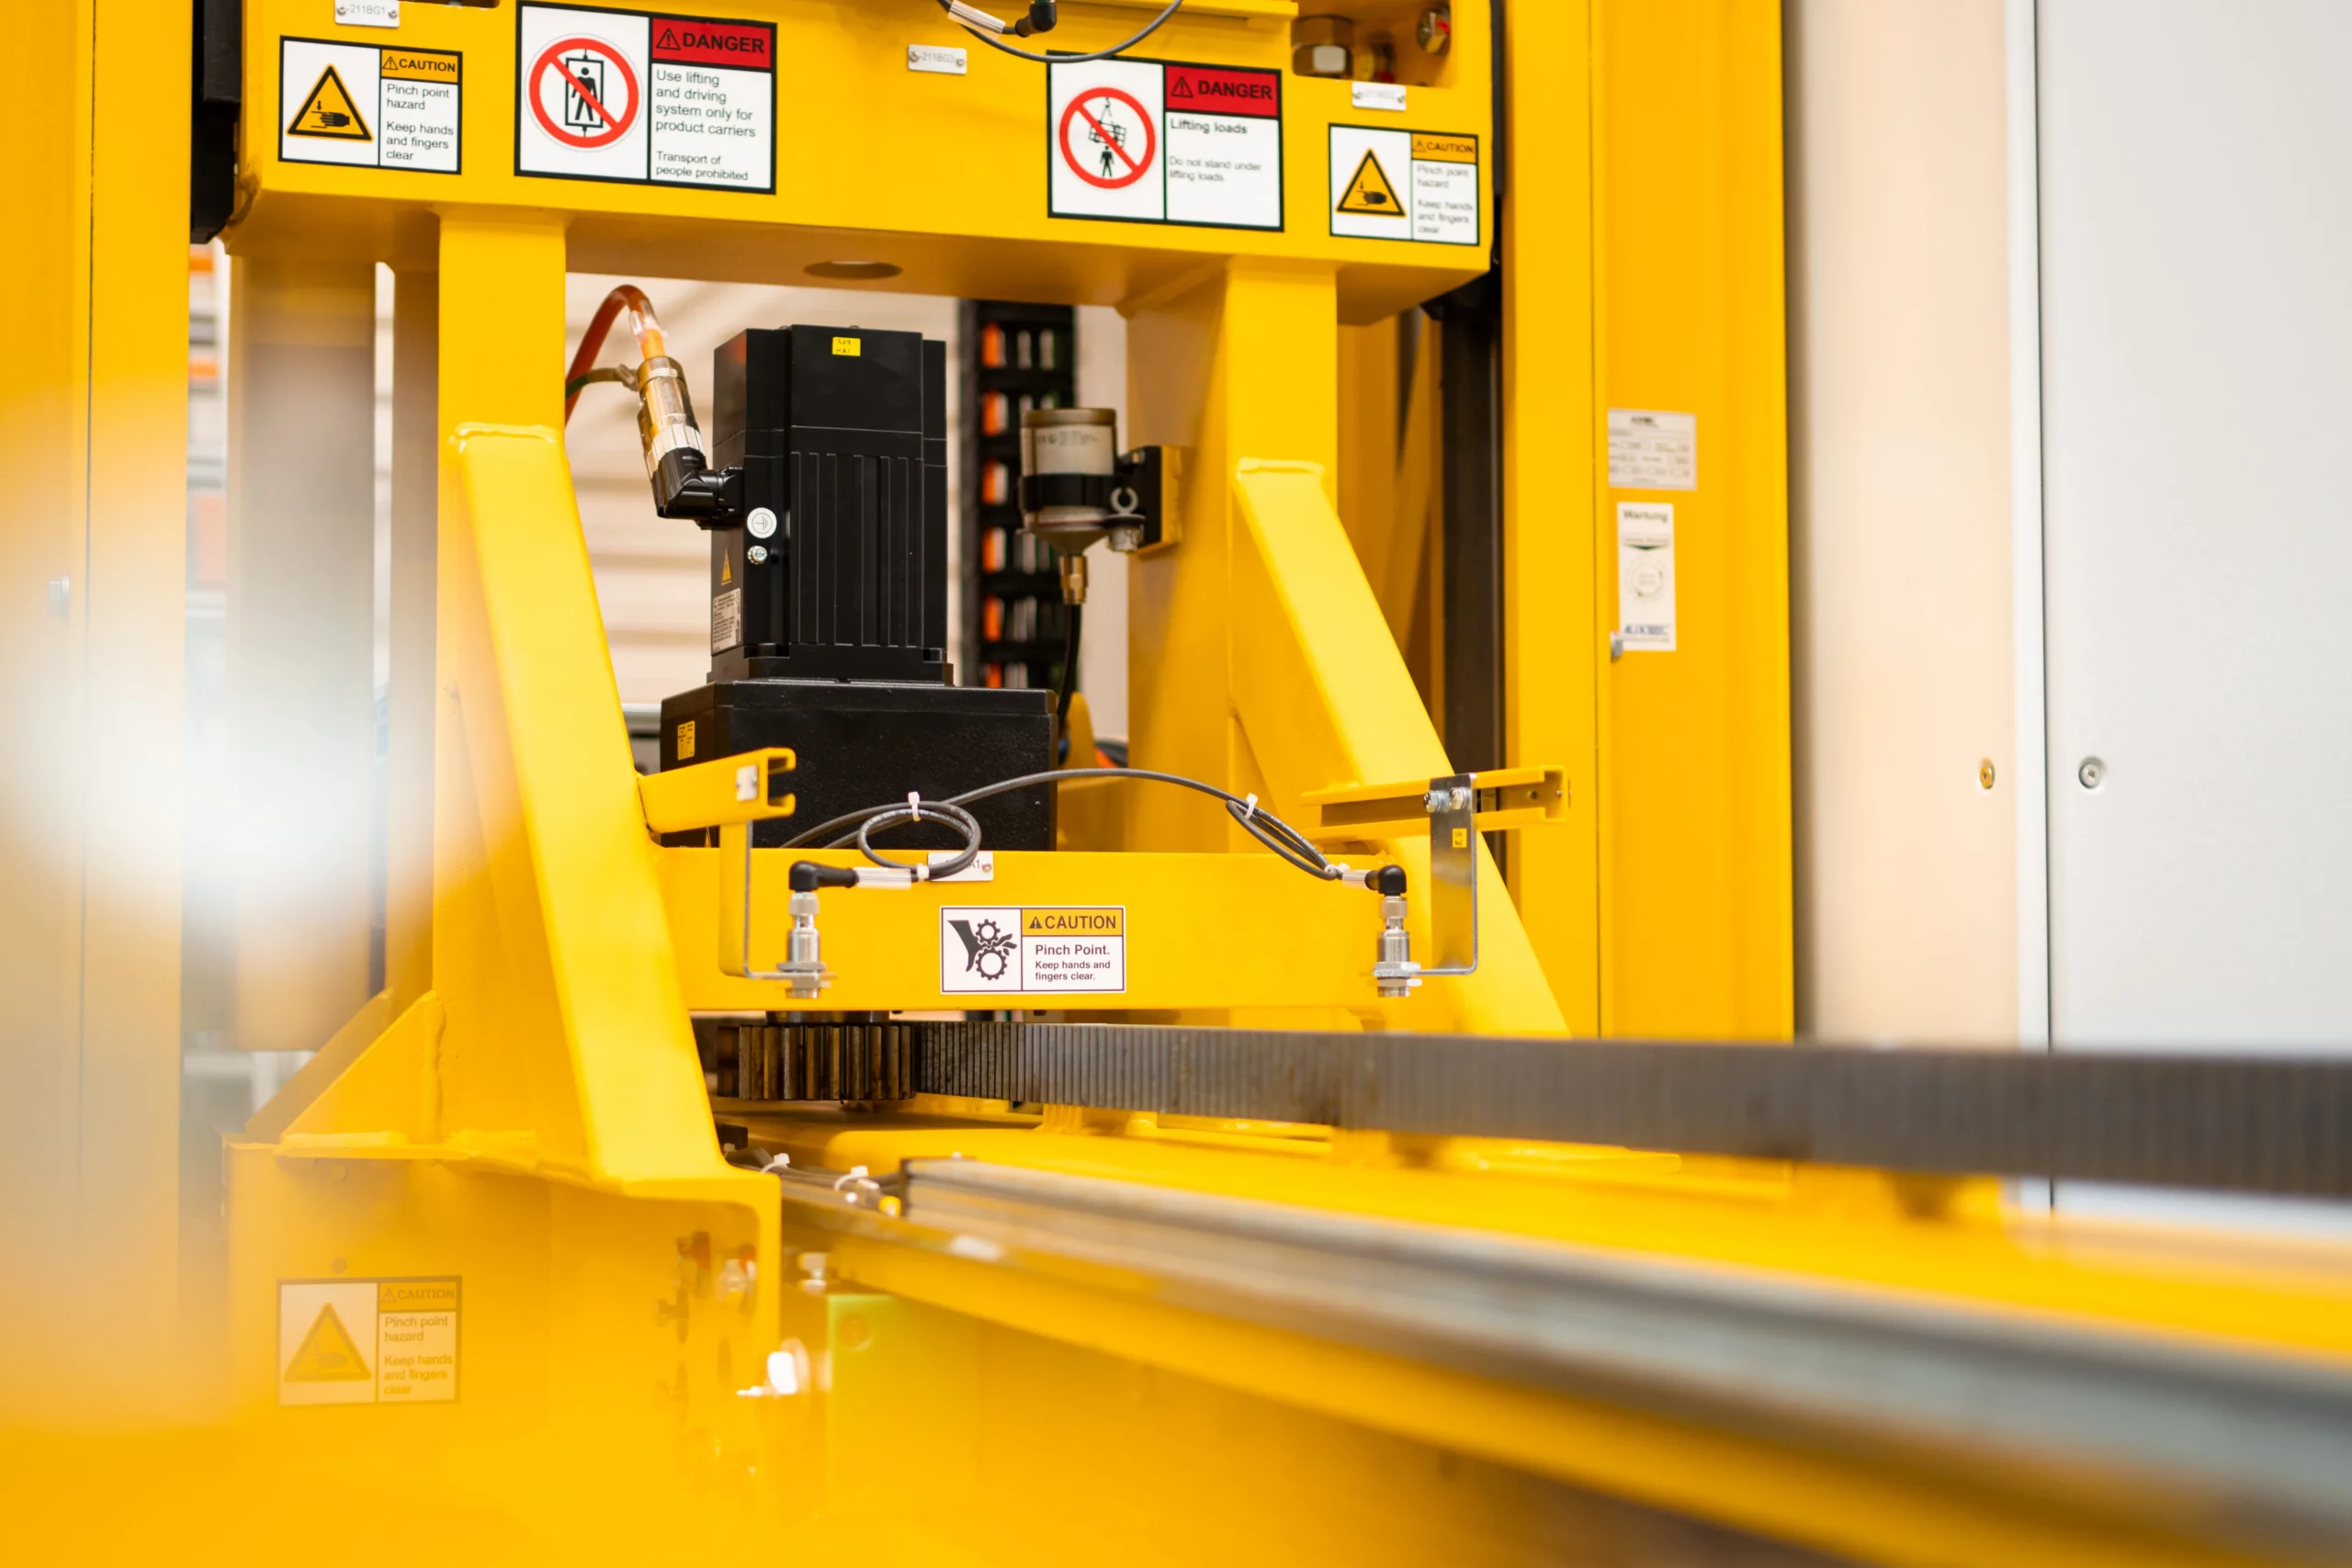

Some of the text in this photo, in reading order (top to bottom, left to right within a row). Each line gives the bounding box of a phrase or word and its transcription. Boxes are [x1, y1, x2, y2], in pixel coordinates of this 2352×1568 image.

[683, 32, 764, 53] DANGER
[399, 59, 456, 72] CAUTION
[656, 70, 719, 88] Use lifting
[387, 84, 449, 98] Pinch point
[656, 88, 726, 105] and driving
[1198, 80, 1272, 100] DANGER
[387, 98, 425, 110] hazard
[656, 105, 753, 121] system only for
[387, 121, 454, 135] Keep hands
[656, 120, 756, 138] product carriers
[1170, 118, 1248, 134] Lifting loads
[386, 136, 448, 150] and fingers
[1426, 141, 1474, 153] CAUTION
[386, 150, 413, 160] clear
[657, 151, 721, 164] Transport of
[1170, 156, 1261, 171] Do not stand under
[656, 166, 748, 181] people prohibited
[1170, 169, 1224, 182] lifting loads
[1439, 212, 1469, 224] fingers
[1045, 916, 1116, 929] CAUTION
[1035, 944, 1110, 955] Pinch Point.
[1035, 961, 1110, 971] Keep hands and
[1035, 972, 1095, 982] fingers clear.
[397, 1289, 455, 1300] CAUTION
[385, 1315, 448, 1328] Pinch point
[385, 1331, 424, 1342] hazard
[384, 1354, 452, 1368] Keep hands
[384, 1369, 447, 1382] and fingers
[383, 1384, 412, 1395] clear
